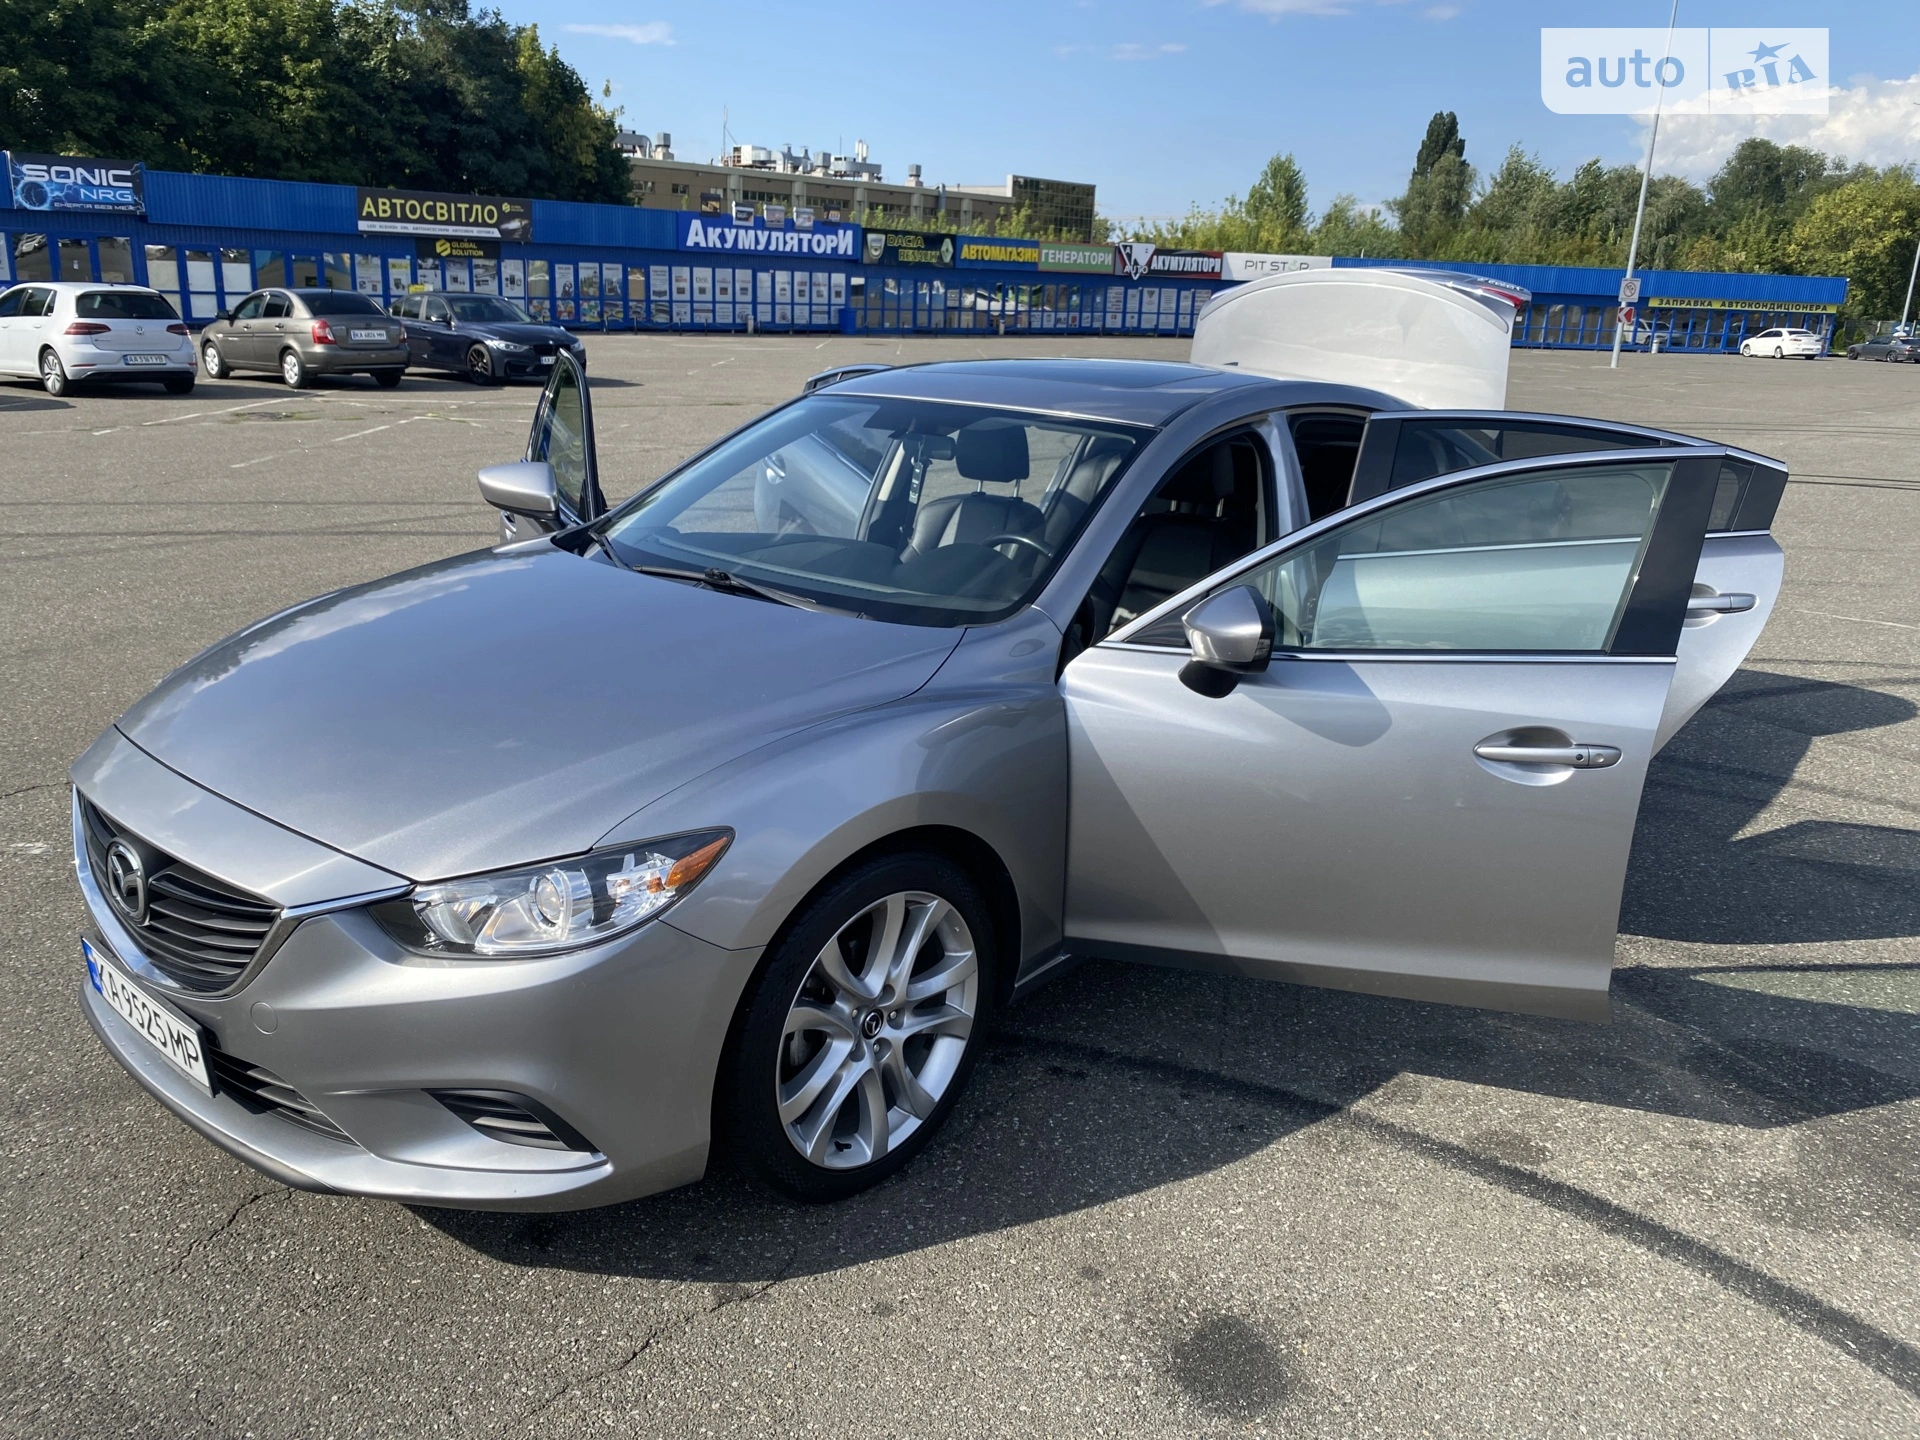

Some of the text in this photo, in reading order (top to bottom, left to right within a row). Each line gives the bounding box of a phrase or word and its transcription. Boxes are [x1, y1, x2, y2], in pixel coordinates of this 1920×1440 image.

[22, 164, 133, 187] SONIC
[80, 188, 132, 201] NRG
[361, 196, 498, 224] АВТОСВІТЛО
[886, 234, 925, 248] DACIA
[960, 244, 1039, 262] АВТОМАГАЗИН
[1041, 249, 1112, 265] ГЕНЕРАТОРИ
[1151, 255, 1221, 272] АКУМУЛЯТОРИ
[1244, 260, 1267, 271] PIT
[1658, 298, 1828, 312] ЗАПРАВКА АВТОКОНДИЦІОНЕРА
[121, 983, 167, 1048] 9525
[166, 1020, 199, 1069] MP
